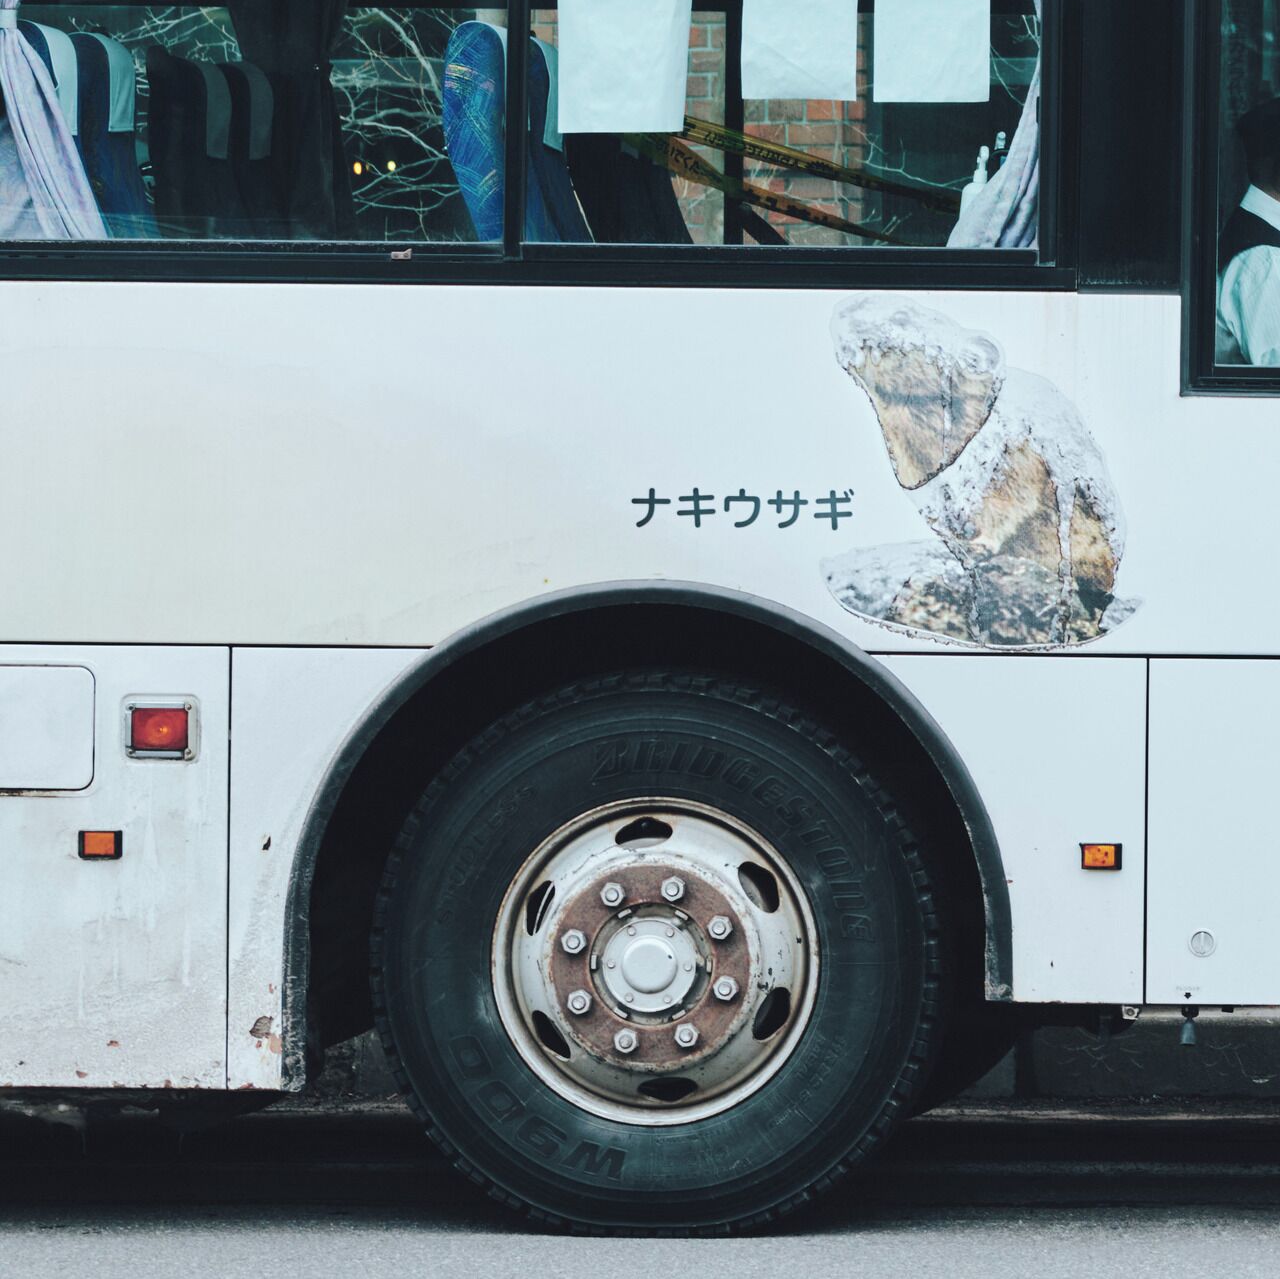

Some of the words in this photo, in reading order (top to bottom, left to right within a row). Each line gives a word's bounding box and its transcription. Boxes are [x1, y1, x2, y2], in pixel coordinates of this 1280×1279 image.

[630, 486, 856, 531] ナキウサギ
[590, 736, 875, 944] BRIDGESTONE
[447, 1033, 628, 1182] W900
